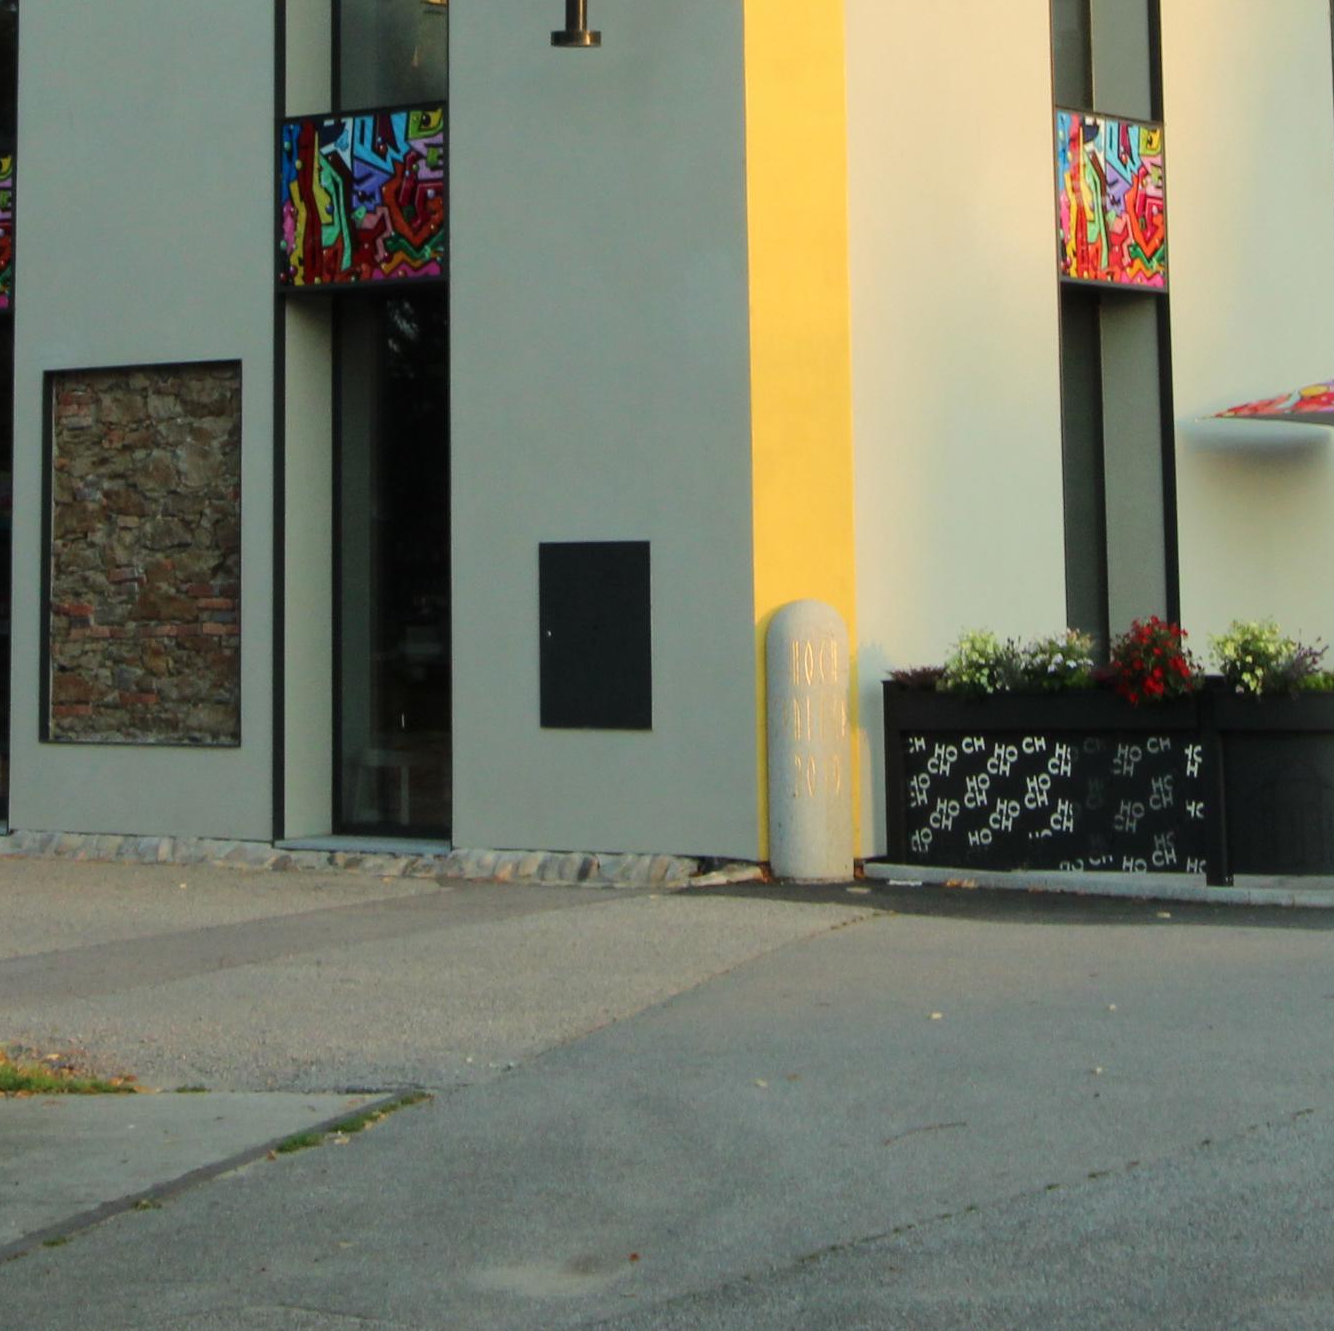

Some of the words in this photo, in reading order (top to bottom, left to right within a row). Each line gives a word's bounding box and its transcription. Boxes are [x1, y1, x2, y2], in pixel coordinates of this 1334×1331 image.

[935, 743, 958, 762] HO
[962, 736, 985, 753] CH
[994, 743, 1018, 762] HO
[1023, 736, 1046, 753] CH
[928, 757, 951, 776] CH
[987, 757, 1011, 777] CH
[966, 773, 990, 792] HO
[1027, 773, 1051, 792] HO
[937, 798, 960, 816] HO
[964, 790, 987, 808] CH
[996, 798, 1020, 817] HO
[1025, 790, 1049, 809] CH
[930, 812, 953, 830] CH
[990, 813, 1012, 832] CH
